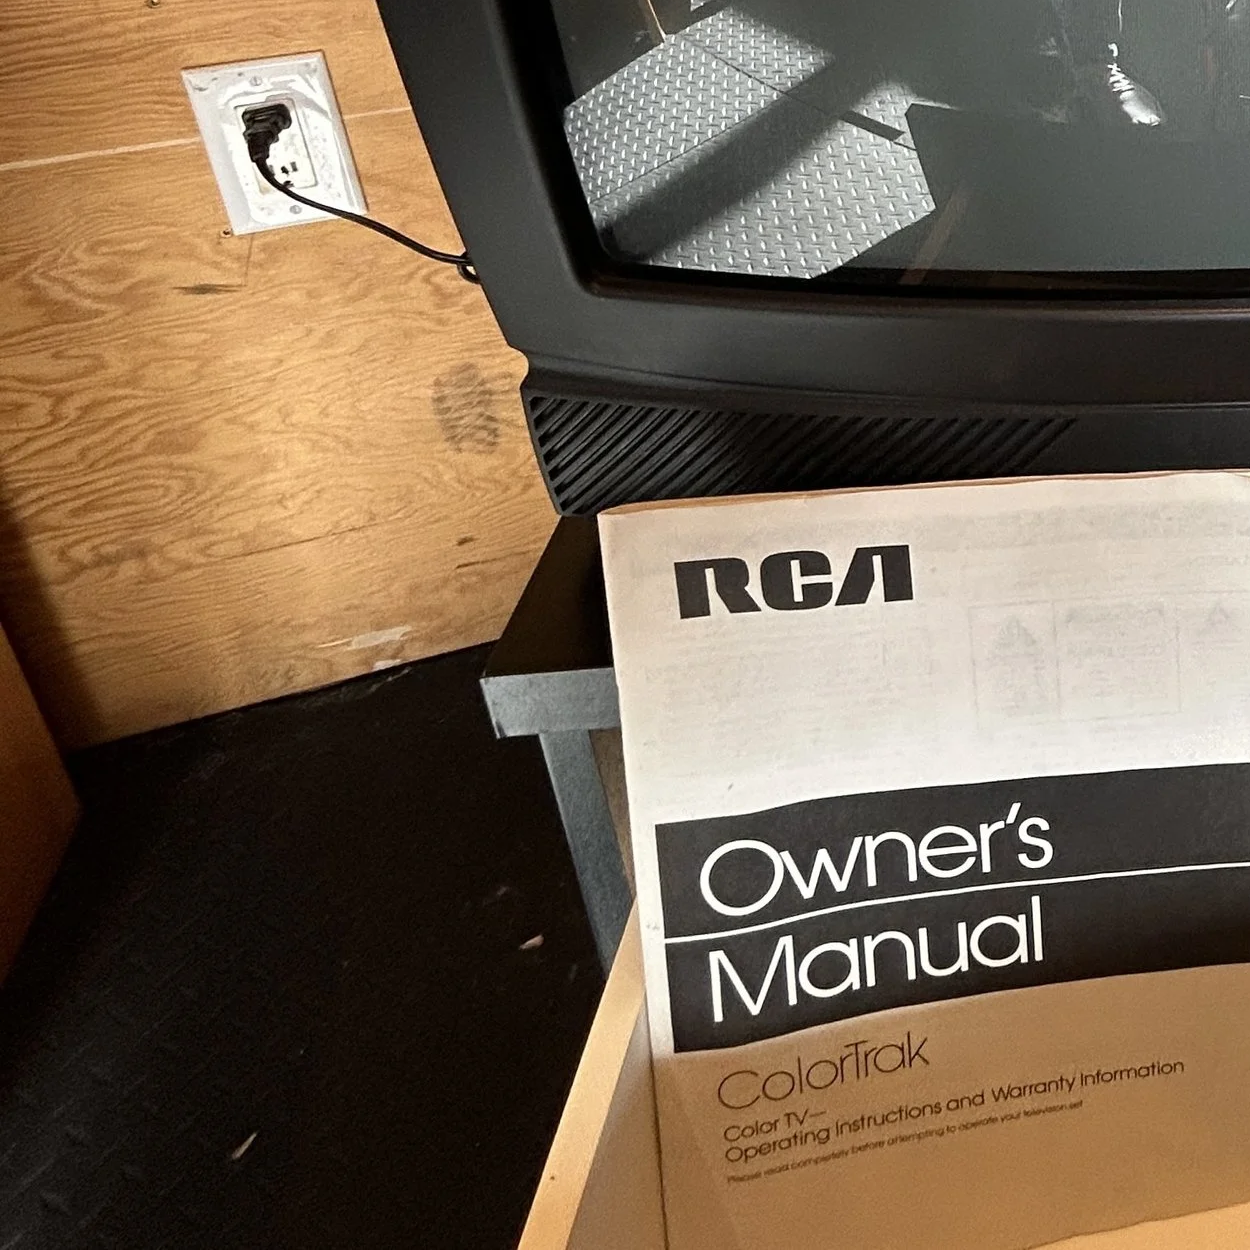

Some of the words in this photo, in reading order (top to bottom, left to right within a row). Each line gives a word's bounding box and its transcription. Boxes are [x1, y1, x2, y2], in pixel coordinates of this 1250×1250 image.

[674, 545, 914, 619] RCA
[699, 801, 1054, 917] Owner's
[708, 896, 1045, 1023] Manual
[718, 1031, 930, 1109] ColorTrak
[724, 1117, 780, 1142] Color
[725, 1127, 831, 1164] Operating
[835, 1101, 942, 1136] Instructions
[946, 1091, 985, 1112] and
[991, 1074, 1076, 1103] Warranty
[1080, 1061, 1185, 1087] Information
[946, 1124, 957, 1135] to
[958, 1116, 999, 1132] operate
[1000, 1111, 1022, 1124] your
